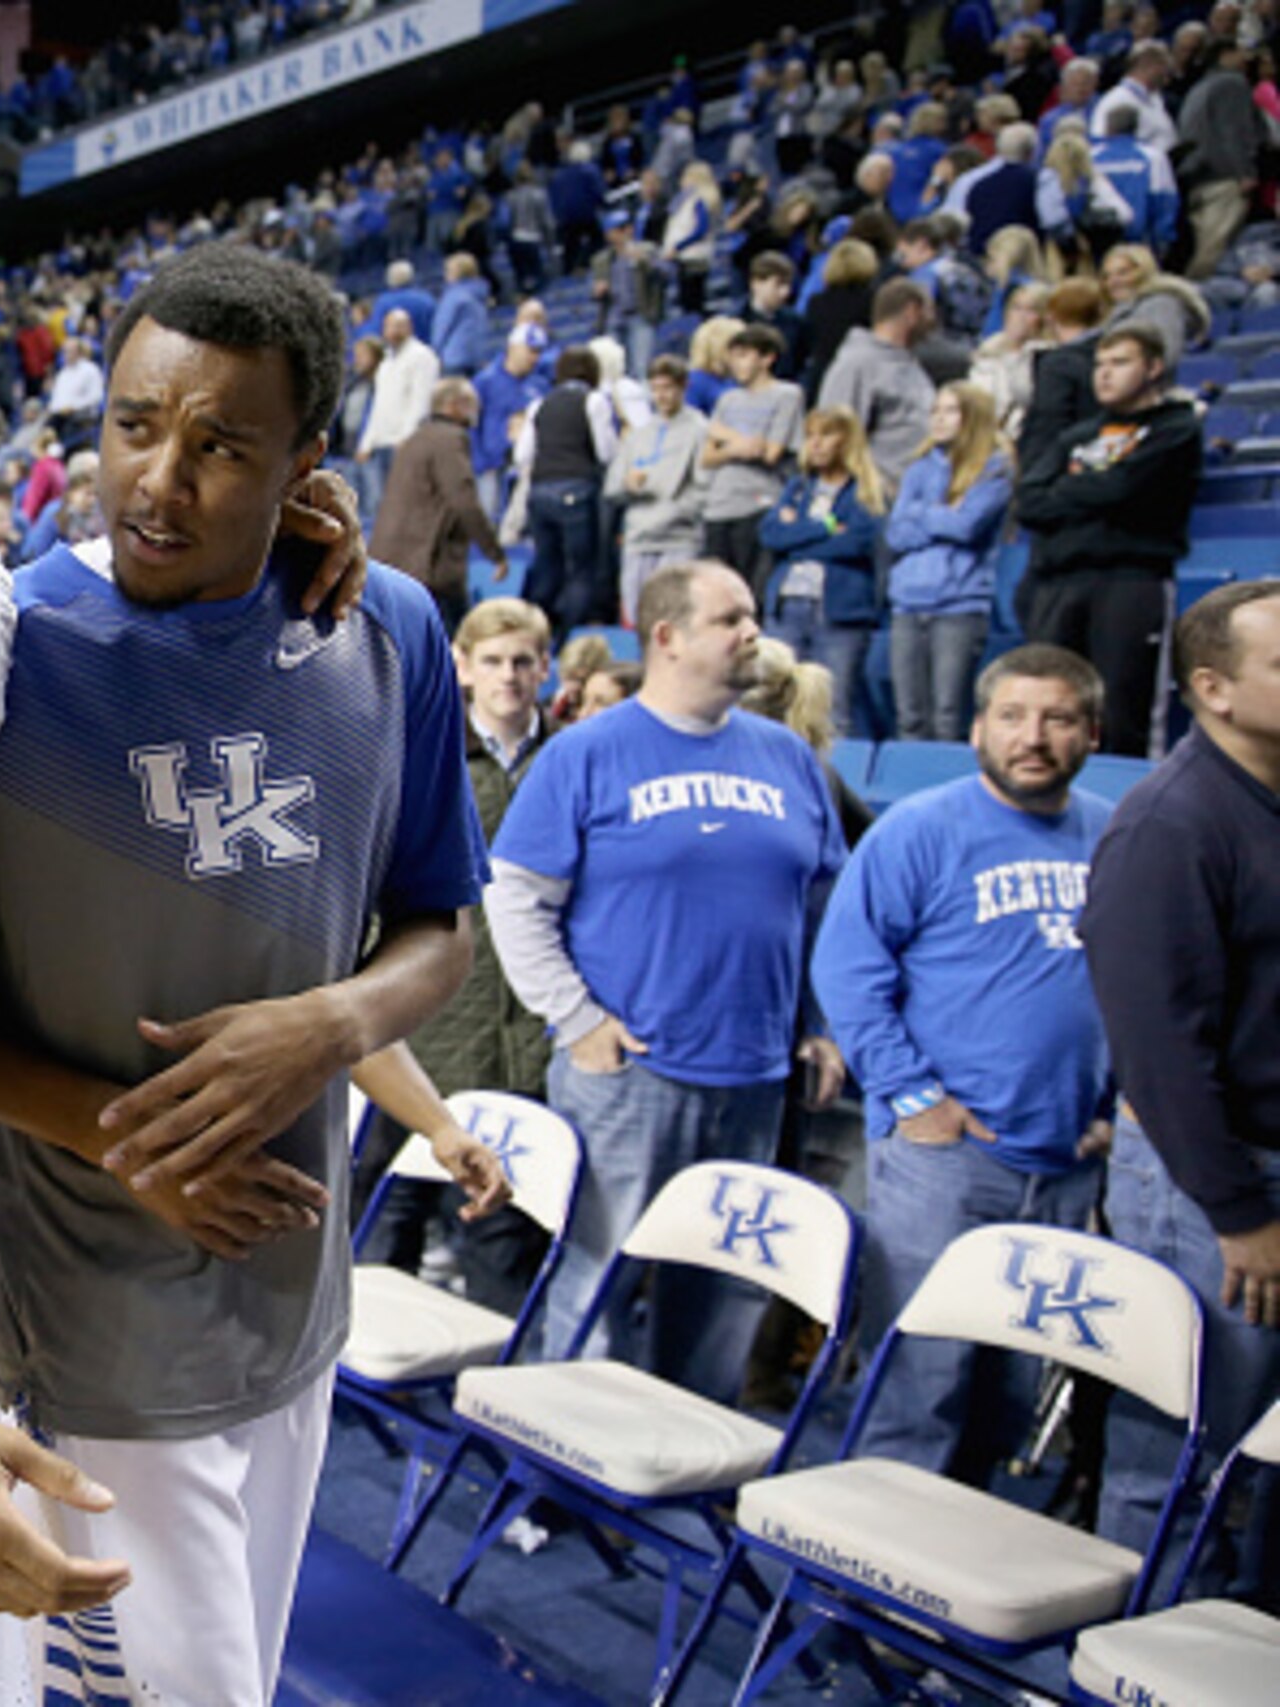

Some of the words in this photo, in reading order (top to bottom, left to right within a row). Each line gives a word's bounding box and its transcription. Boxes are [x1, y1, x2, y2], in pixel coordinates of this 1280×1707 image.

[133, 57, 303, 142] WHITAKER
[322, 17, 425, 79] BANK
[128, 731, 320, 880] UK
[628, 771, 786, 824] KENTUCKY
[705, 1172, 797, 1271] UK
[998, 1236, 1123, 1356] UK
[761, 1516, 953, 1617] UKathletics.com
